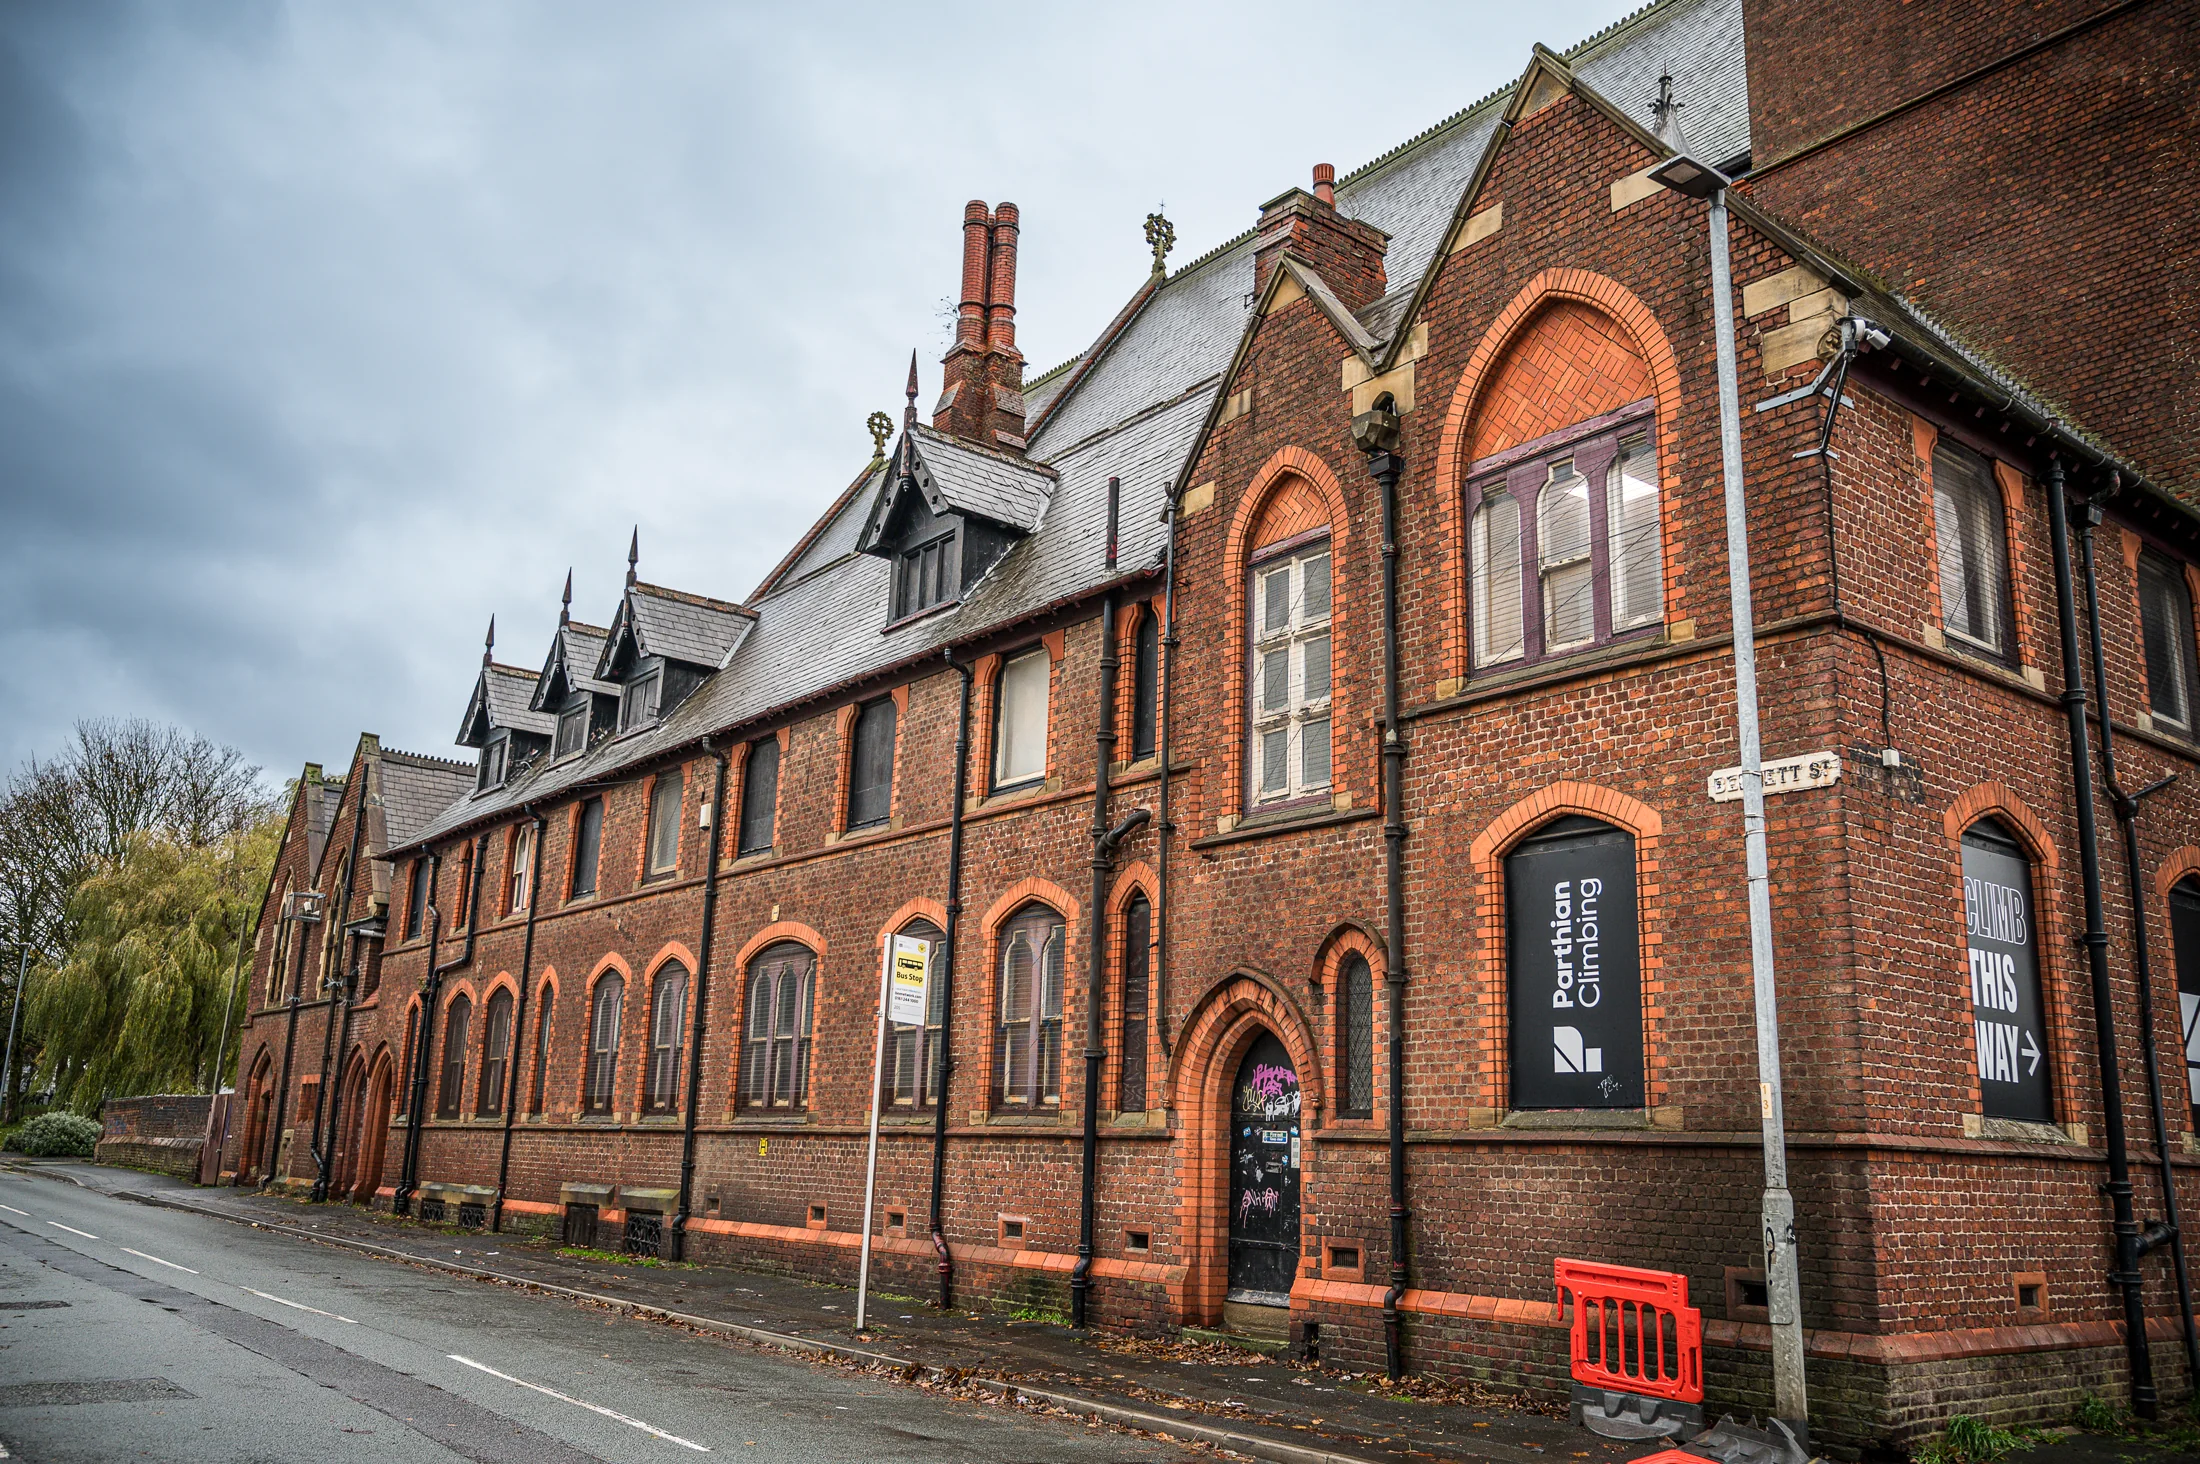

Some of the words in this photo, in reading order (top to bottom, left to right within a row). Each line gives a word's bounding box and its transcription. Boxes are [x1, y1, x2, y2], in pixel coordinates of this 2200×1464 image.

[1714, 764, 1803, 794] BEETT
[1576, 877, 1602, 1008] Climbing
[1963, 876, 2027, 945] CLIMB
[909, 974, 923, 983] Stop
[1550, 881, 1574, 1009] Parthian
[1968, 947, 2018, 1014] THIS
[1975, 1020, 2019, 1084] WAY
